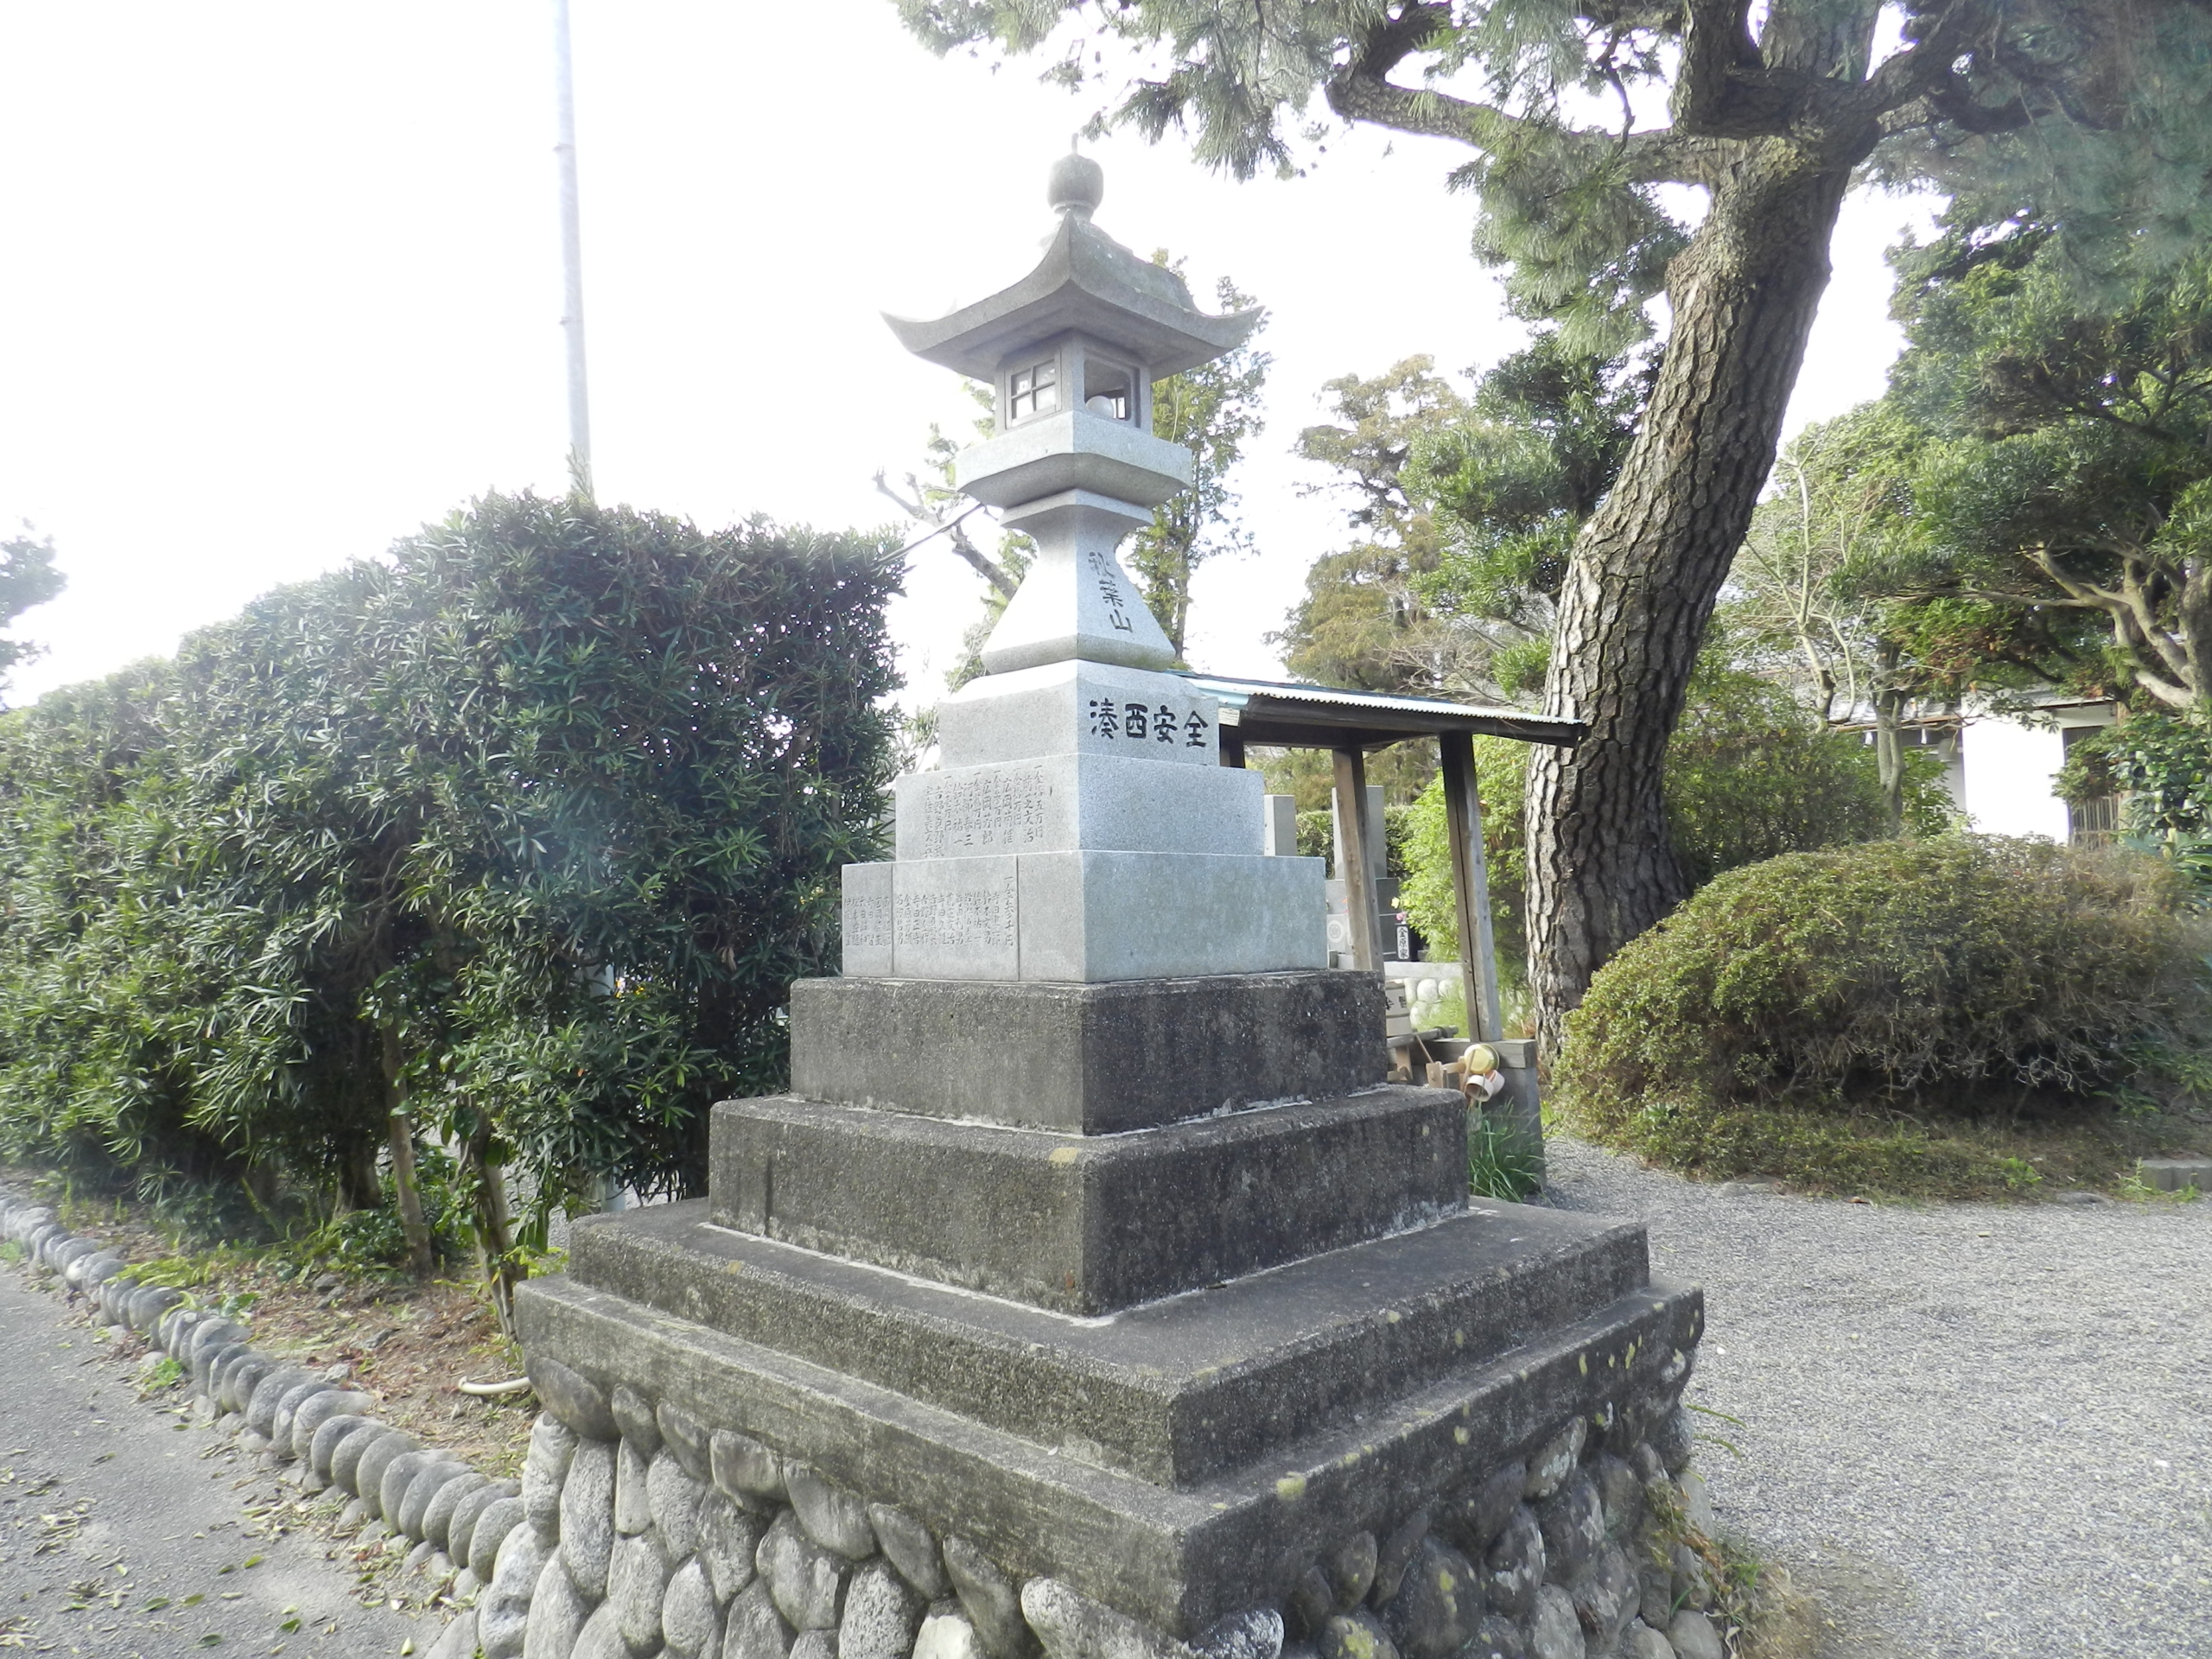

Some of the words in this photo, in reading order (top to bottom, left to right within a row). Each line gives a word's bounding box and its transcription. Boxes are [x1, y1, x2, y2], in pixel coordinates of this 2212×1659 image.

[1089, 697, 1209, 748] 湊西安全
[1398, 927, 1408, 959] 金原家
